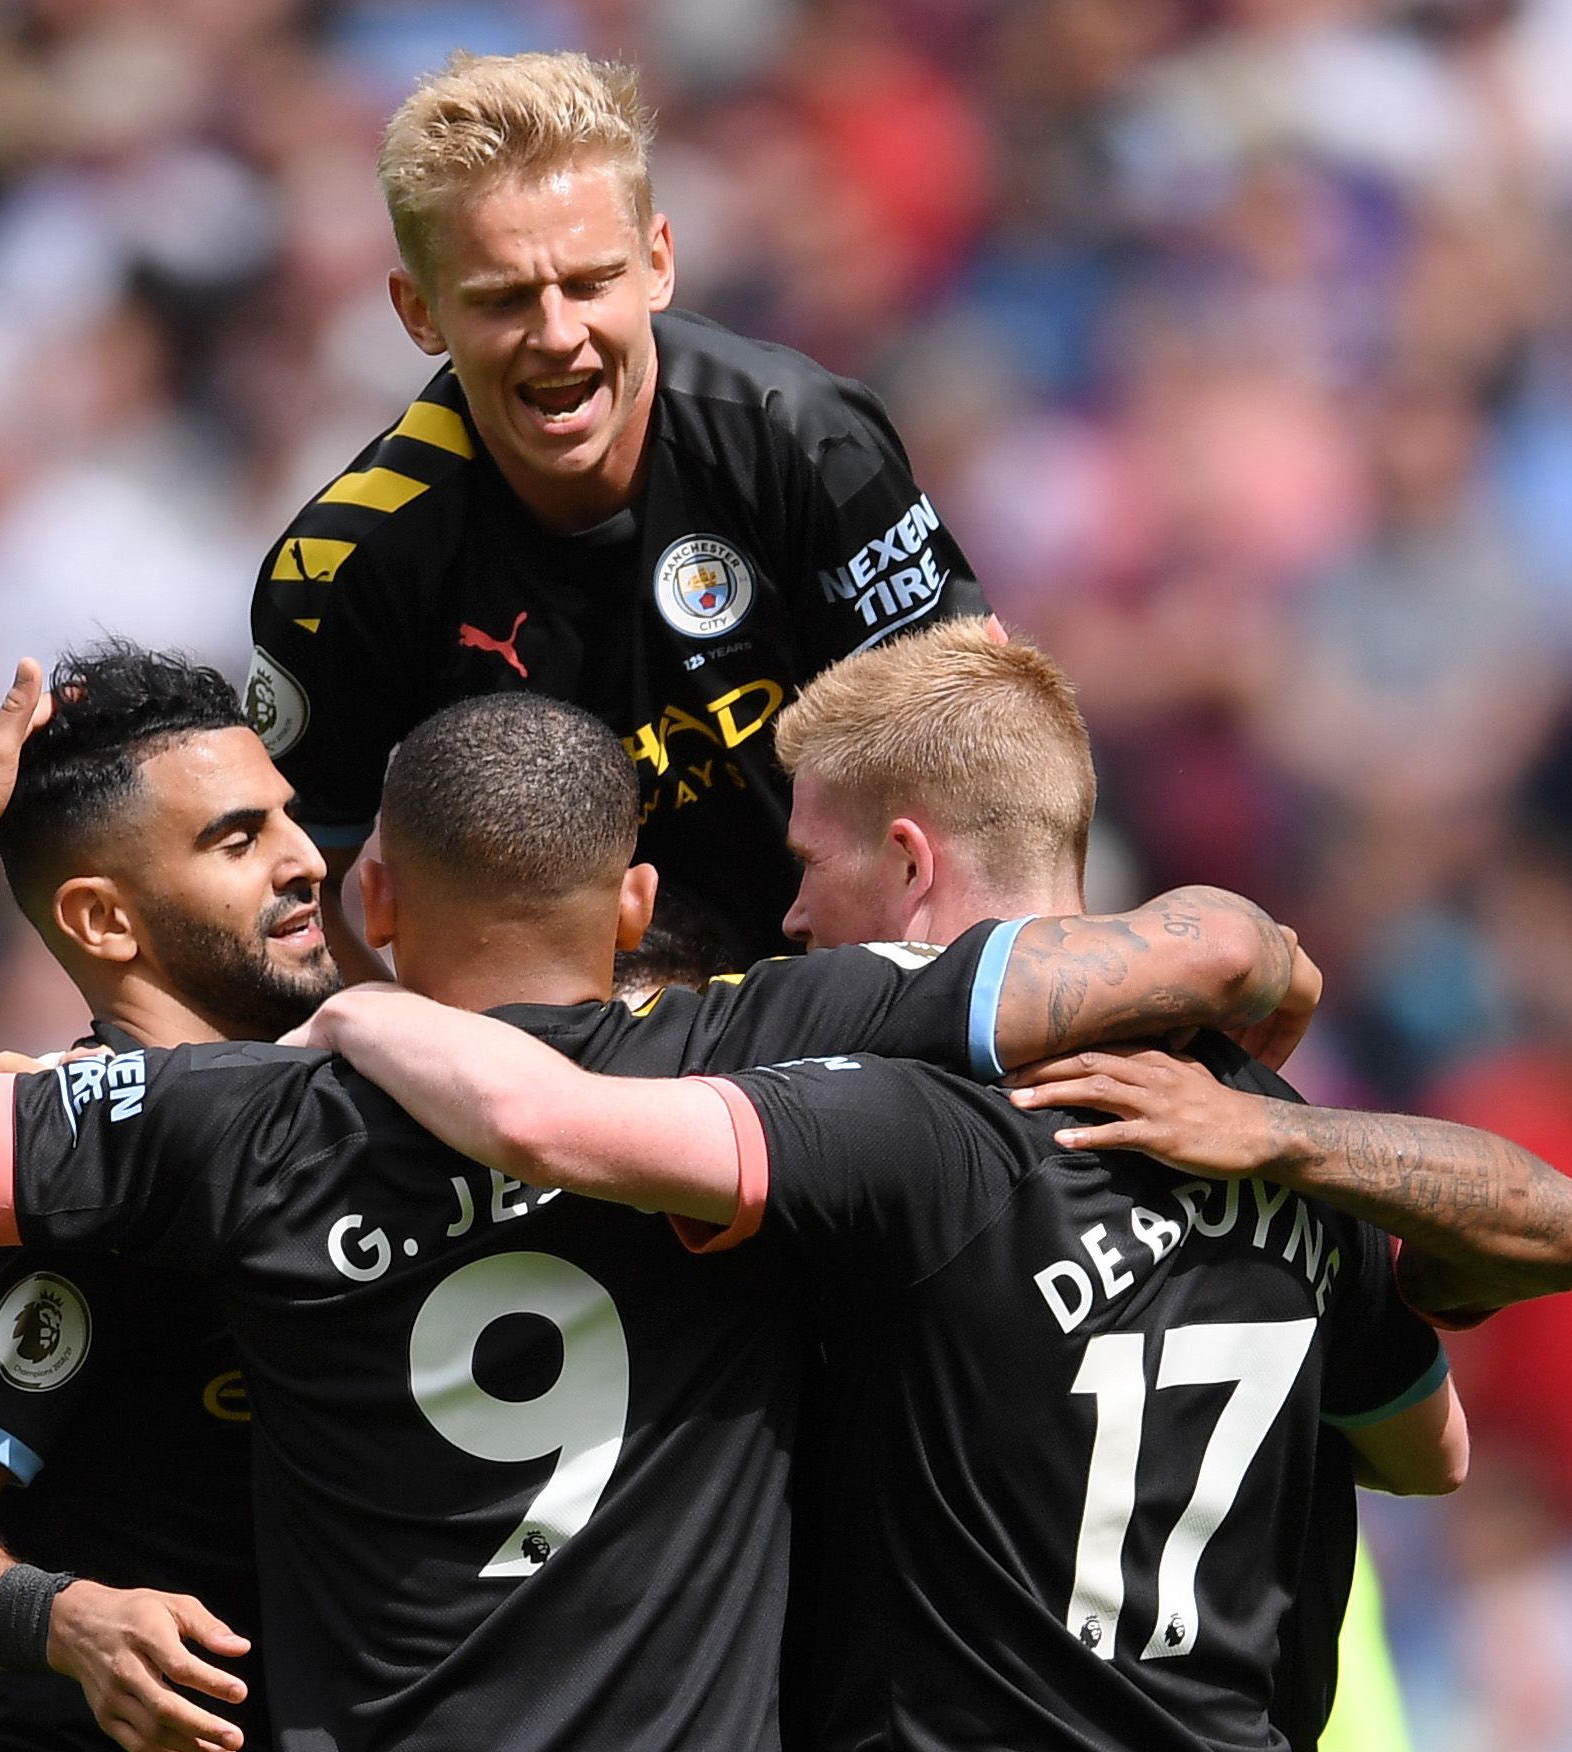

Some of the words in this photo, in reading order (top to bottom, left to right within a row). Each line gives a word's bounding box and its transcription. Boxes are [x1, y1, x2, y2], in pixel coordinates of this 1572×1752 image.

[663, 542, 741, 582] MANCHESTER
[819, 492, 940, 603] NEXEN
[854, 546, 941, 627] TIRE
[683, 652, 706, 672] 125
[708, 641, 753, 660] YEARS
[699, 617, 728, 632] CITY
[327, 1213, 419, 1283] G.
[1033, 1222, 1135, 1335] DE
[409, 1250, 630, 1579] 9
[1065, 1317, 1319, 1663] 17
